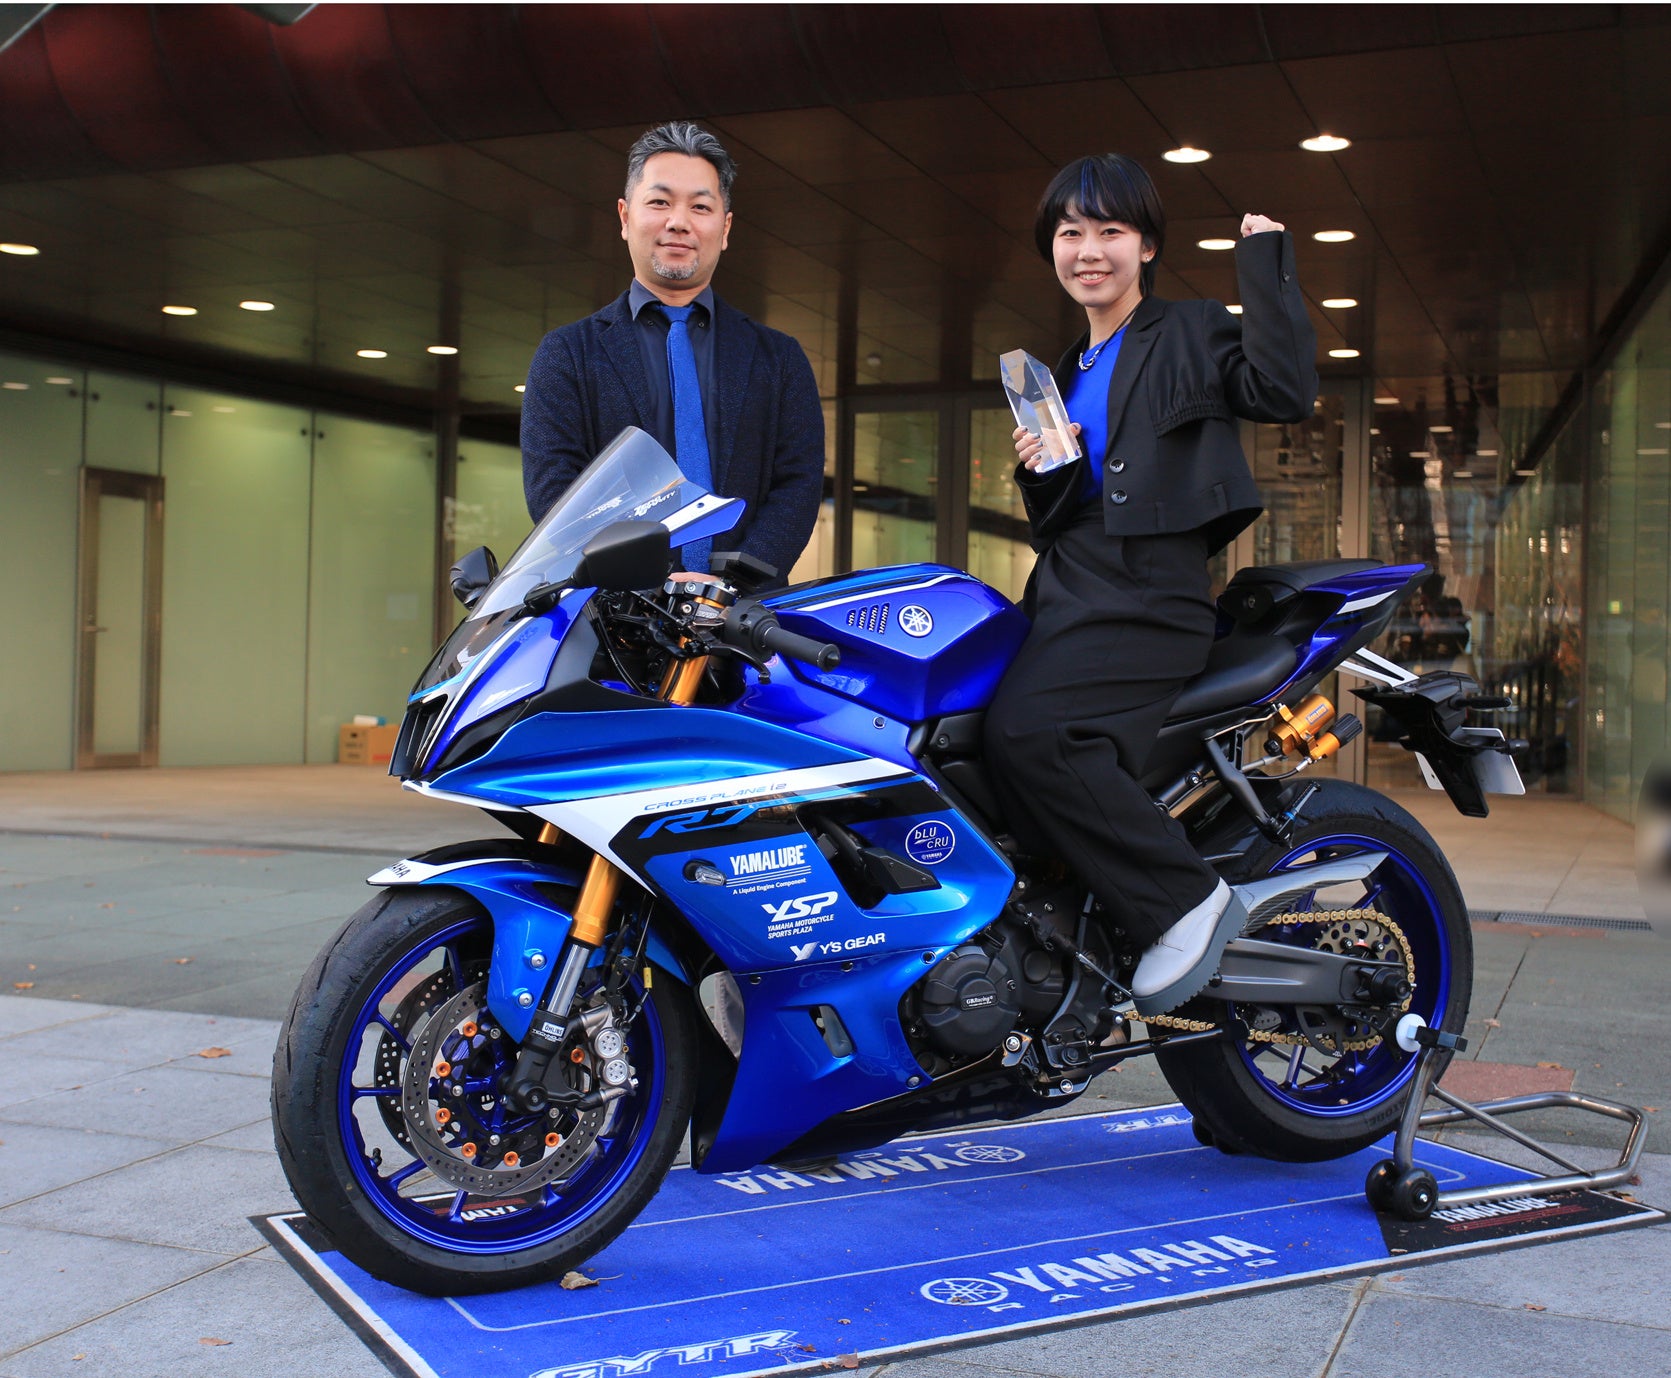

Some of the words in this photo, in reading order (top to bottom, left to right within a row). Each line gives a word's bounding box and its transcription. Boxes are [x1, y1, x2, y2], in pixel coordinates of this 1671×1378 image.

[644, 795, 707, 811] CROSS
[709, 785, 766, 801] PLANE
[638, 802, 762, 840] R7
[738, 886, 756, 895] Liquid
[756, 884, 775, 892] Engine
[775, 878, 807, 888] Component
[761, 891, 839, 923] YSP
[767, 920, 794, 932] YAMAHA
[794, 914, 835, 928] MOTORCYCLE
[768, 930, 792, 940] SPORTS
[792, 926, 813, 935] PLAZA
[820, 941, 843, 955] Y'S
[844, 933, 886, 950] GEAR
[714, 1151, 972, 1195] YAMAHA
[989, 1234, 1276, 1293] YAMAHA
[988, 1258, 1279, 1313] RACING
